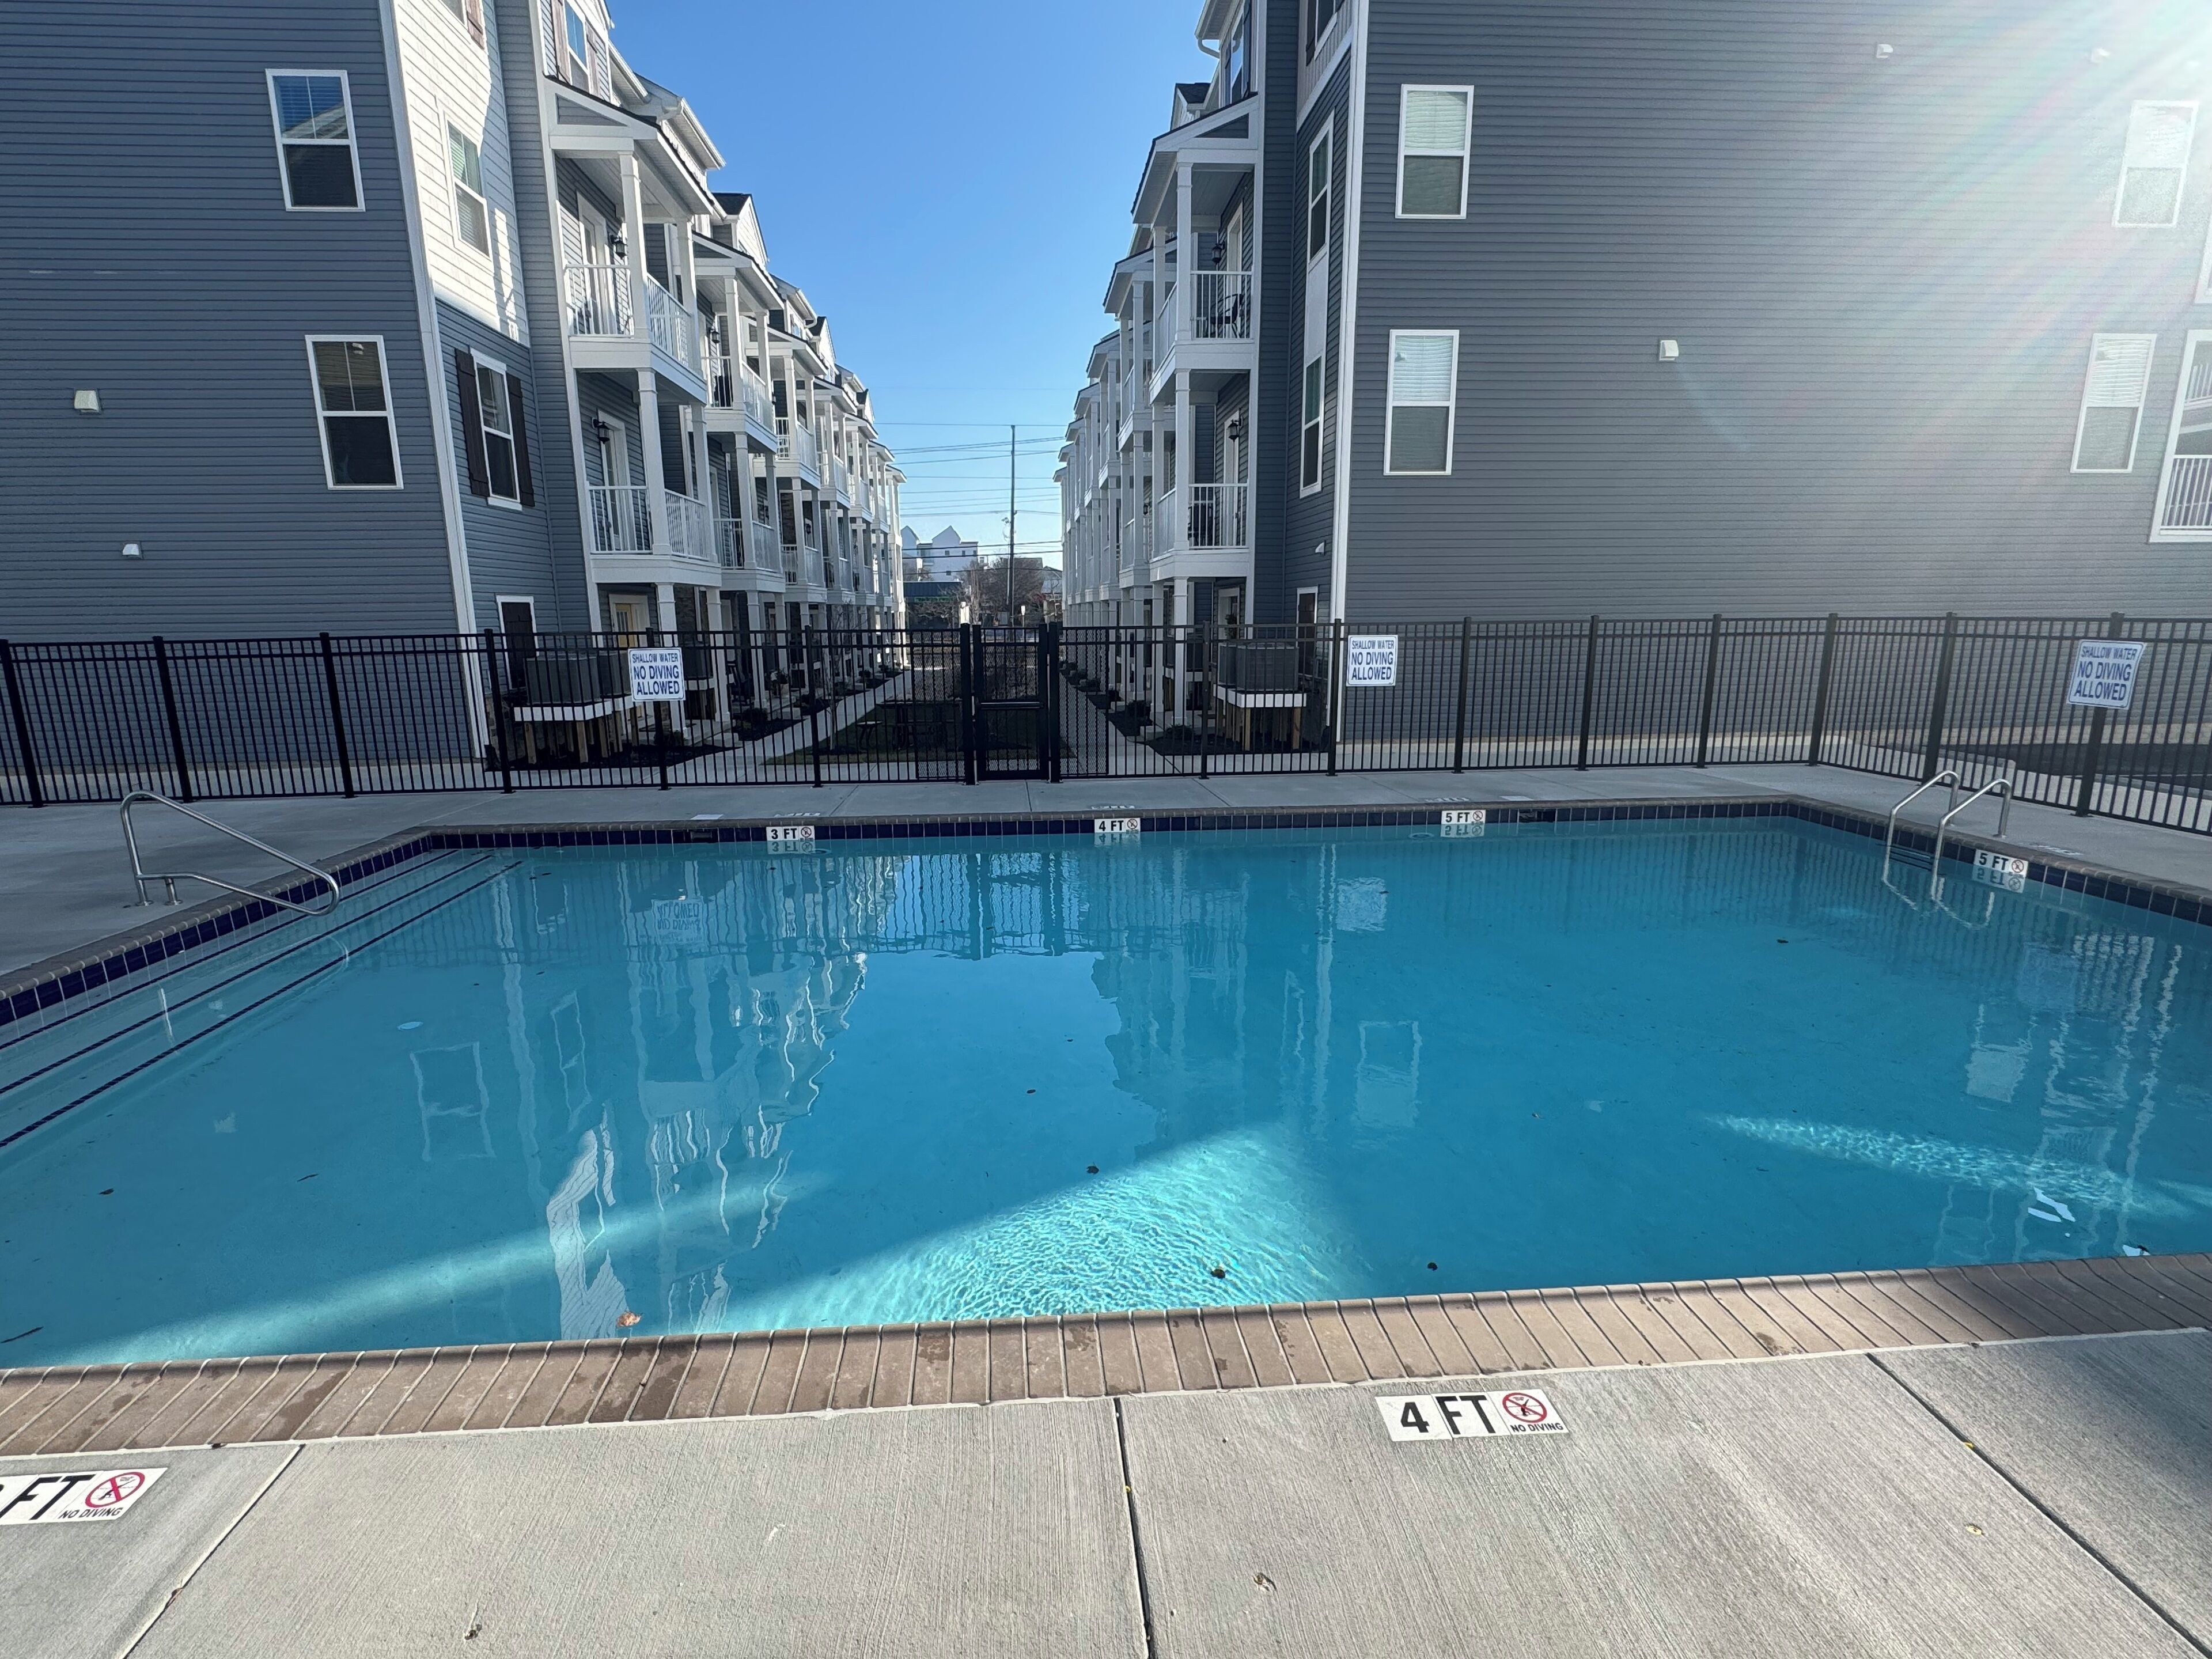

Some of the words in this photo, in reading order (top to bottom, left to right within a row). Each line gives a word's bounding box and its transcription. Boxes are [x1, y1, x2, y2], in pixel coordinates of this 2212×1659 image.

[1352, 640, 1376, 649] SHALLOW
[1377, 640, 1394, 649] WATER
[632, 653, 657, 663] SHALLOW
[660, 653, 678, 662] WATER
[1351, 652, 1363, 665] NO
[1366, 652, 1393, 665] DIVING
[2082, 646, 2111, 658] SHALLOW
[2113, 647, 2137, 660] WATER
[634, 666, 646, 680] NO
[649, 665, 679, 679] DIVING
[1351, 666, 1392, 680] ALLOWED
[2077, 661, 2093, 678] NO
[2095, 662, 2131, 681] DIVING
[637, 681, 679, 695] ALLOWED
[2074, 680, 2126, 700] ALLOWED
[1445, 813, 1452, 823] 5
[1457, 812, 1470, 822] FT
[1099, 821, 1106, 831] 4
[1111, 820, 1124, 831] FT
[771, 829, 778, 839] 3
[783, 828, 797, 839] FT
[1979, 853, 1988, 865] 5
[1992, 855, 2009, 871] FT
[1400, 1402, 1430, 1433] 4
[1435, 1395, 1496, 1435] FT
[1510, 1425, 1527, 1433] NO
[1528, 1422, 1563, 1432] DIVING
[0, 1474, 96, 1520] FT
[58, 1510, 78, 1519] NO
[79, 1507, 123, 1518] DIVING
